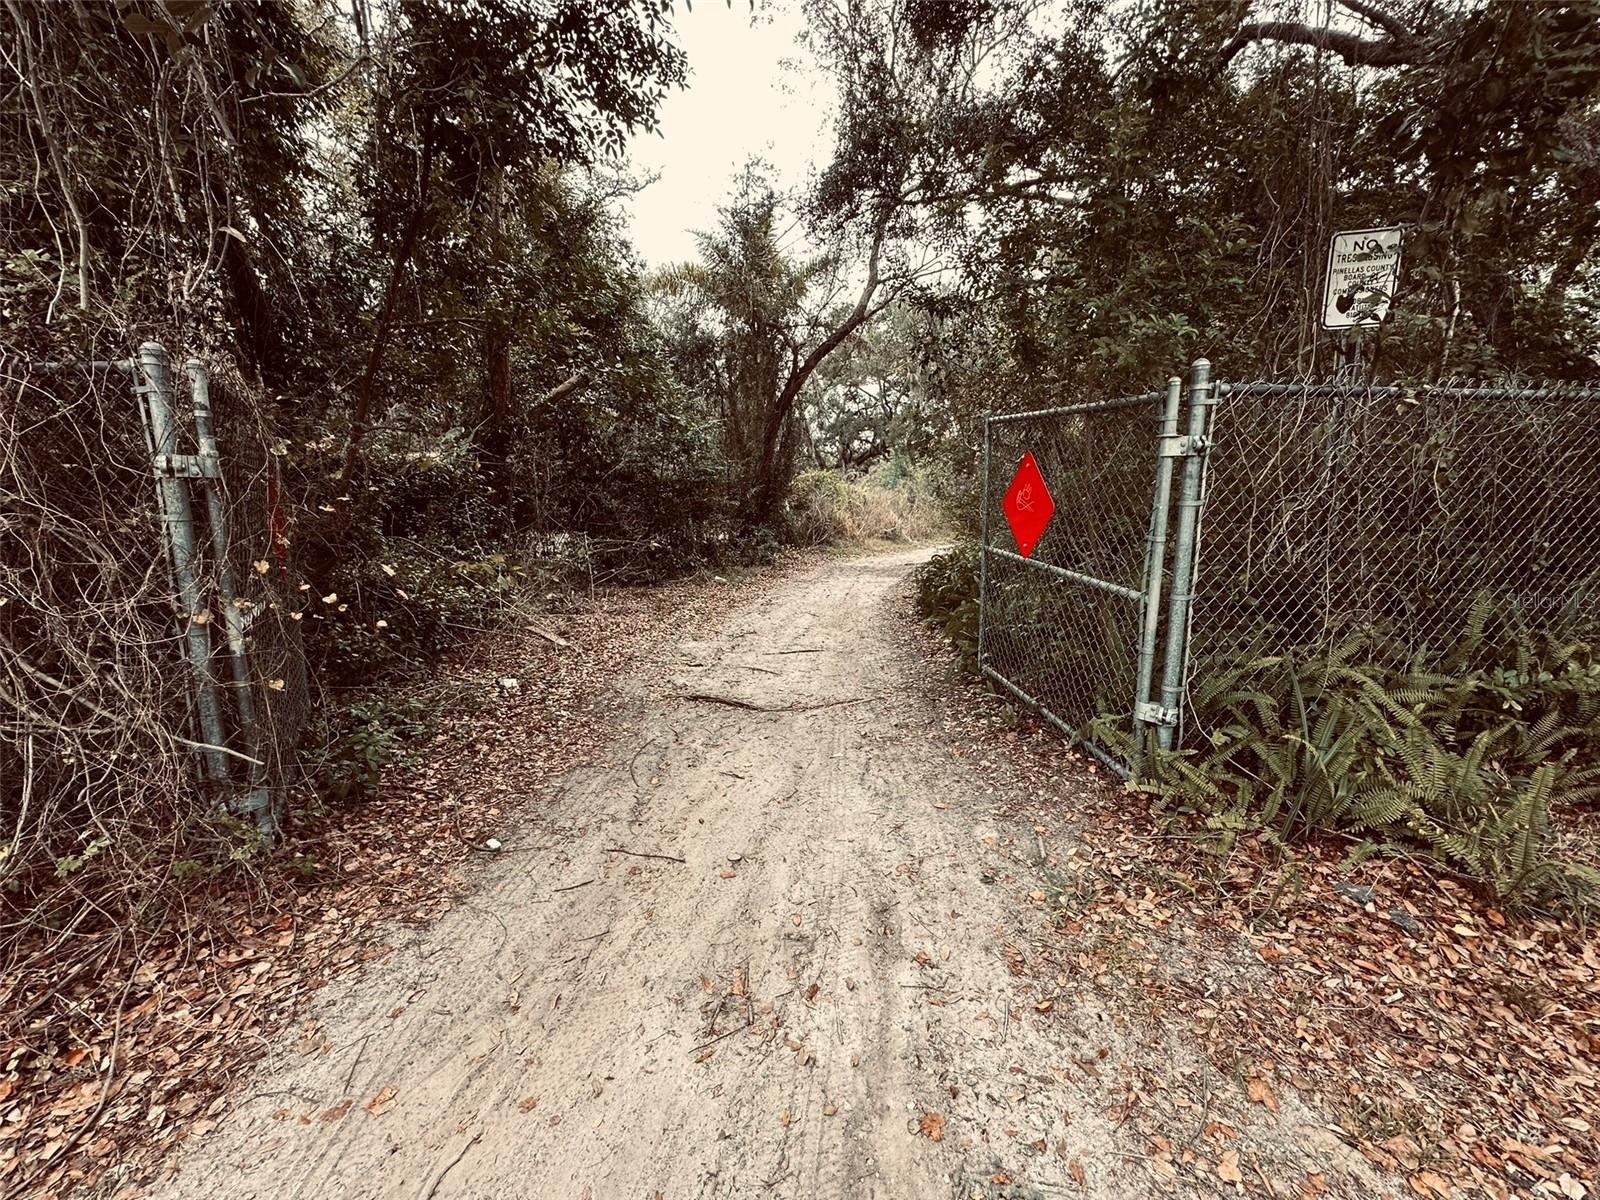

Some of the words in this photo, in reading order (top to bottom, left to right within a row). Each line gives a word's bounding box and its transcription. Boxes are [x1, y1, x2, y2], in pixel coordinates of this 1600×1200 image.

[1353, 239, 1380, 252] NO
[1337, 251, 1393, 263] TRESSSING
[1332, 266, 1365, 275] PINELLAS
[1366, 264, 1394, 273] COUNTY
[1343, 273, 1366, 281] BOARD
